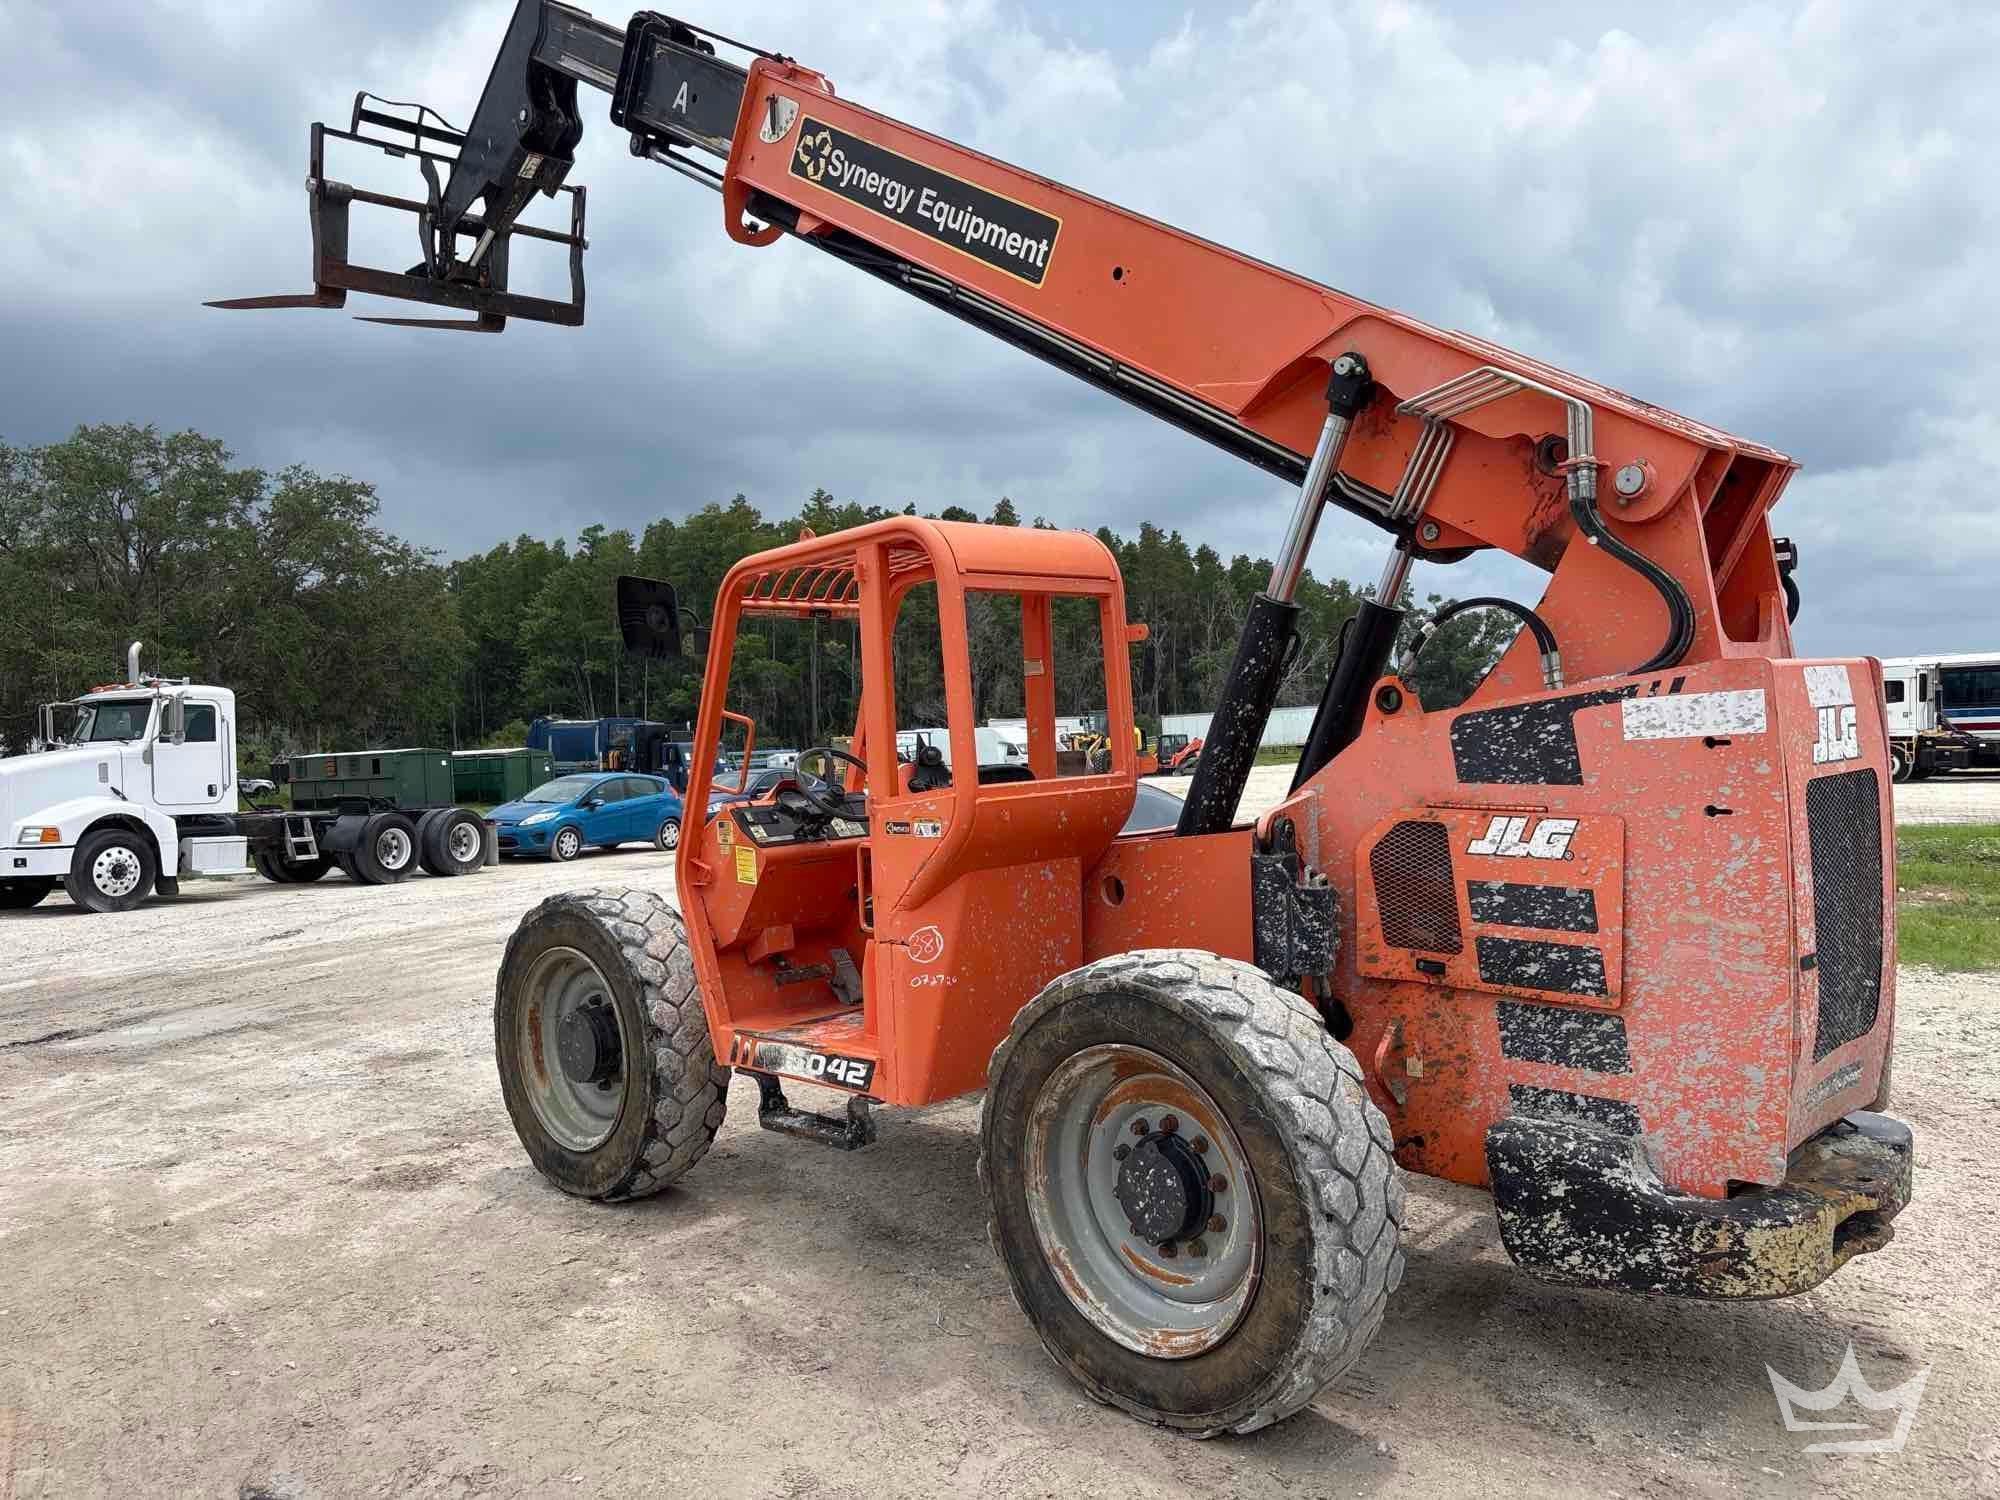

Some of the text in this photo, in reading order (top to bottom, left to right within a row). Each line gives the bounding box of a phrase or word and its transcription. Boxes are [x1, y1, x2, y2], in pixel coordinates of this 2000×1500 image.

[672, 80, 689, 115] A
[828, 148, 1049, 268] Synergy Equipment
[1812, 703, 1862, 765] JLG
[1465, 815, 1580, 861] JLG
